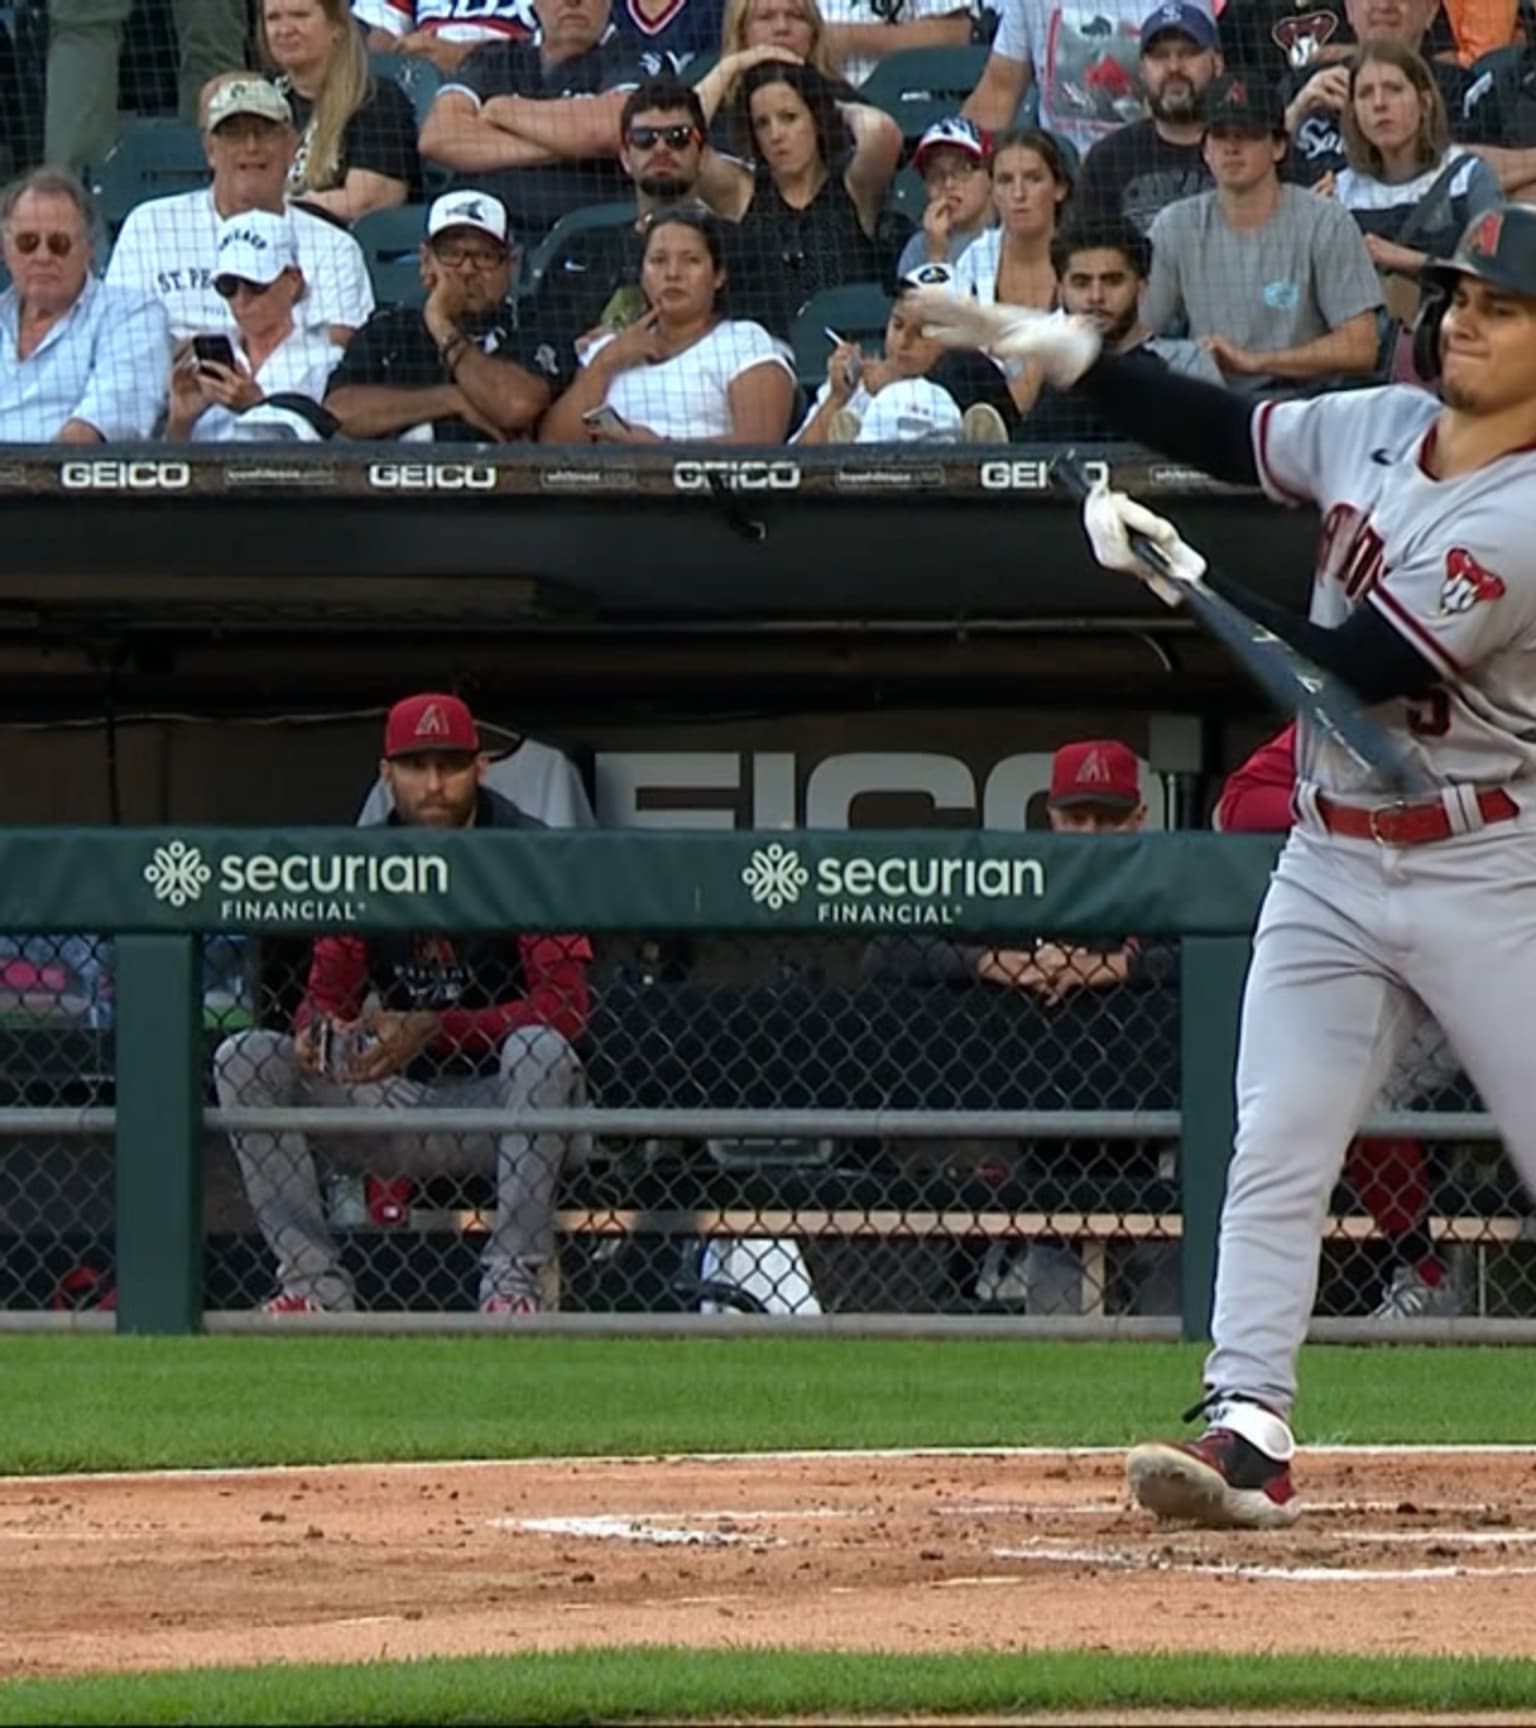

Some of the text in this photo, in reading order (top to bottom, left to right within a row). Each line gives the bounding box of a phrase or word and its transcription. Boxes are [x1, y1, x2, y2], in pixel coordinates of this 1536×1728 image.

[62, 462, 189, 488] GEICO
[369, 464, 495, 488] GEICO
[981, 461, 1109, 488] GEIO
[220, 855, 447, 892] securian
[817, 858, 1043, 896] securian
